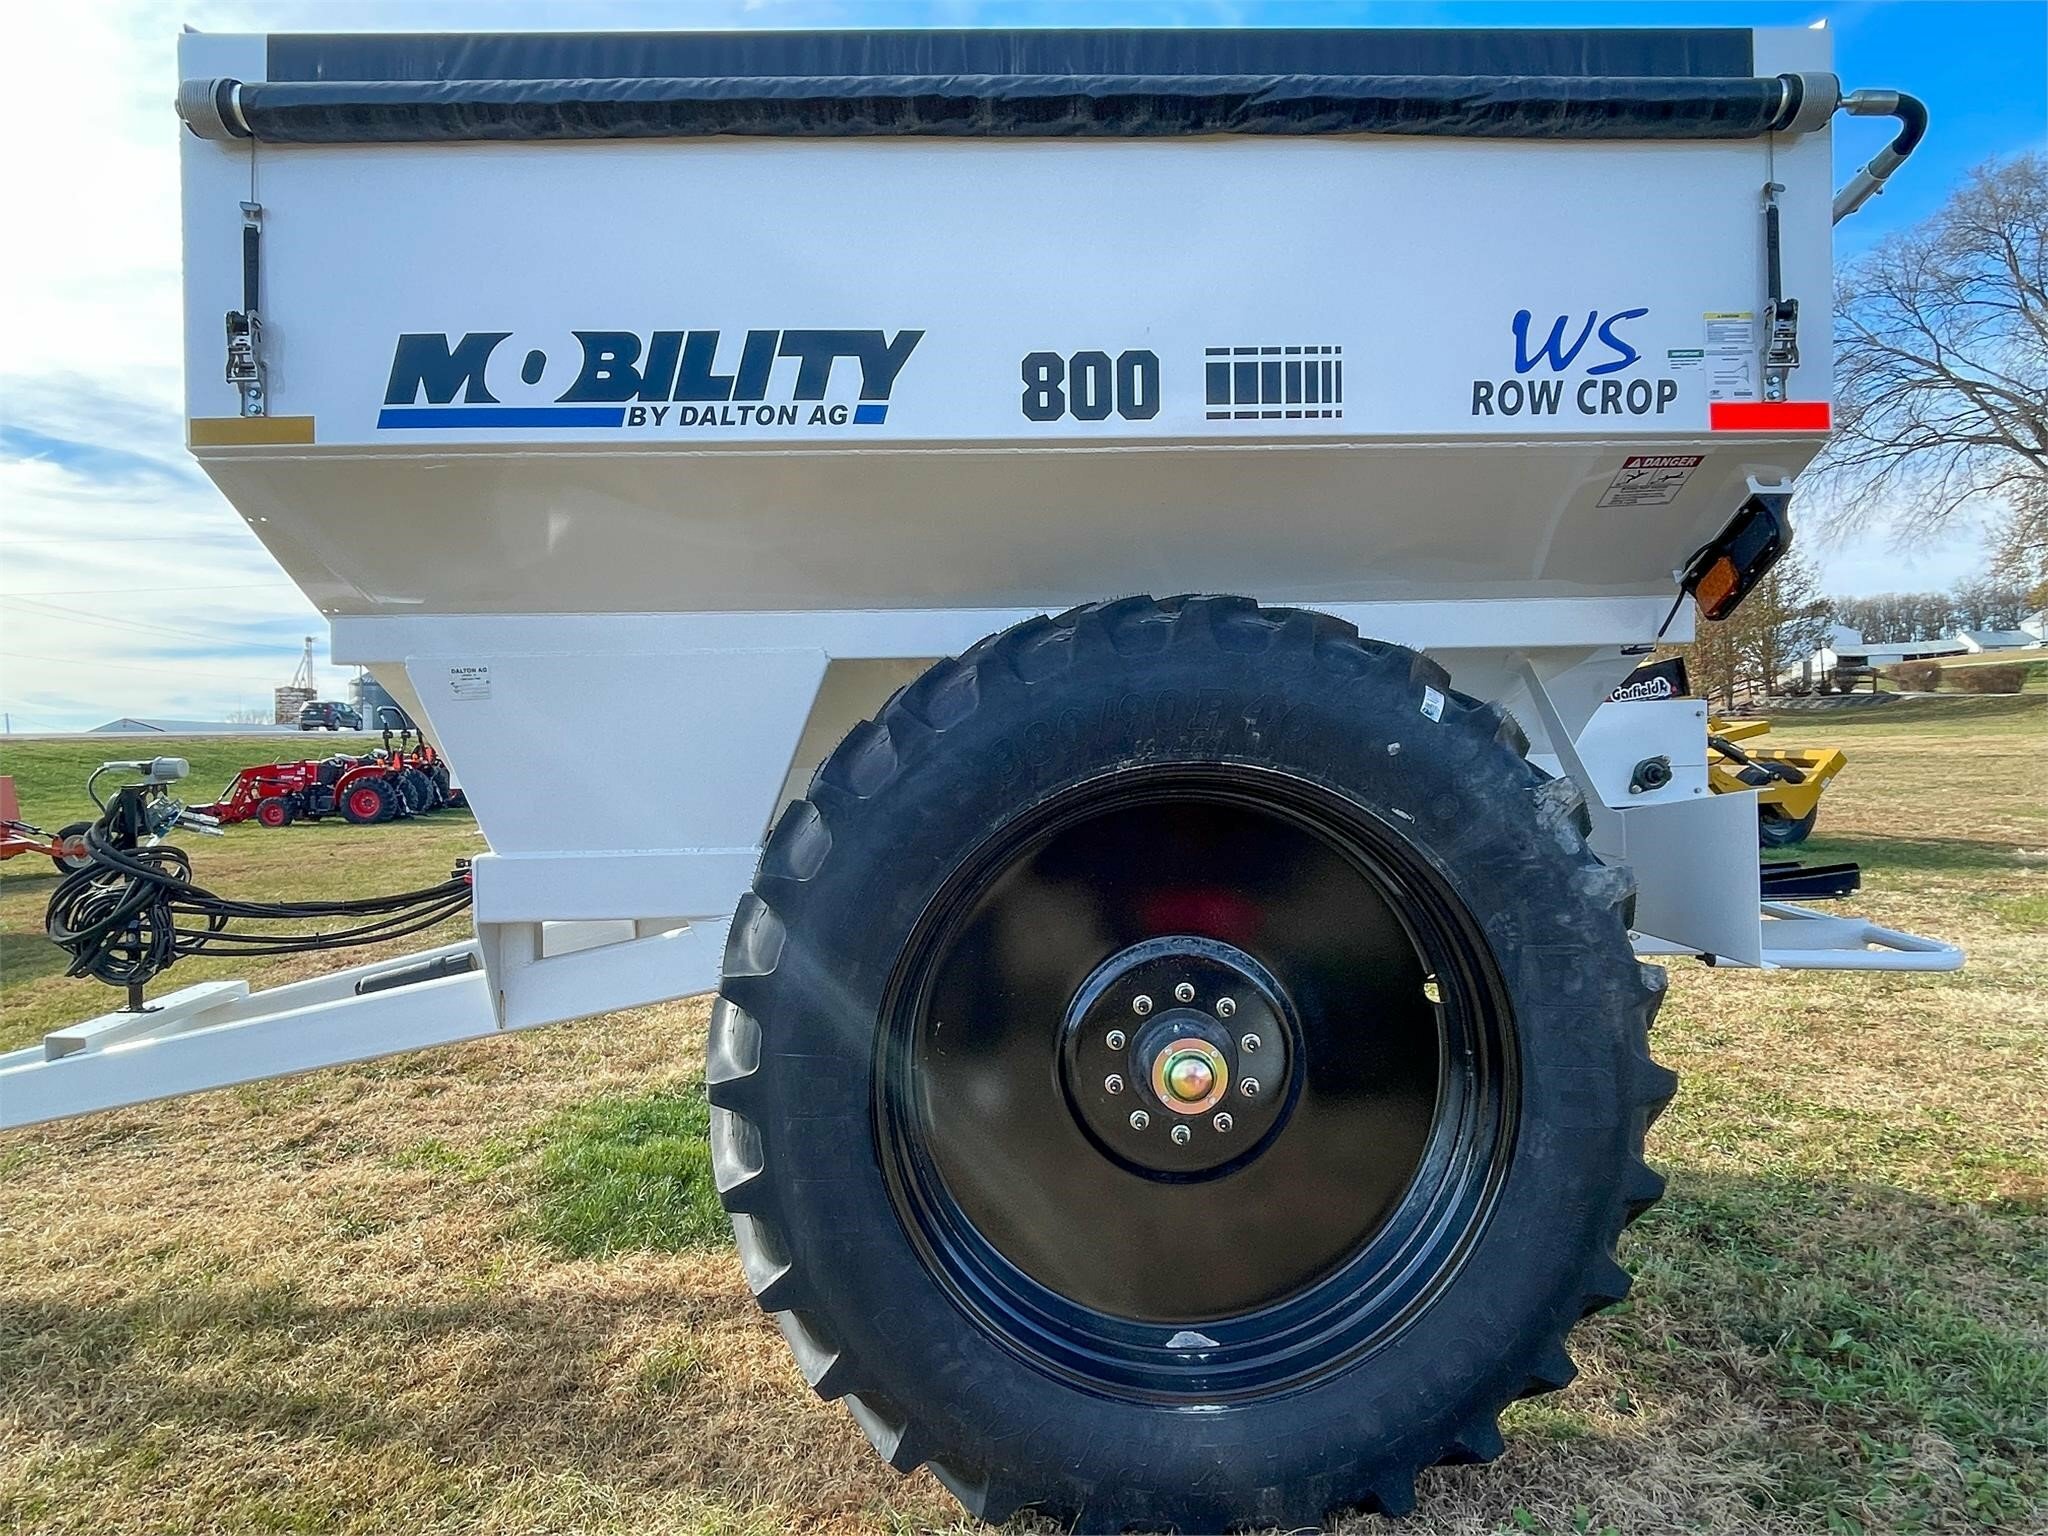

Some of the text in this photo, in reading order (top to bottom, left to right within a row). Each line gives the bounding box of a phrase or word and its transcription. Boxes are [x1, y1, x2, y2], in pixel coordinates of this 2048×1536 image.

[1512, 308, 1649, 375] WS
[384, 330, 925, 405] MOBILITY
[1021, 349, 1160, 421] 800
[627, 405, 848, 427] BY DALTON AG
[1471, 379, 1678, 416] ROW CROP
[1643, 457, 1698, 467] DANGER
[1611, 680, 1660, 700] Garfield
